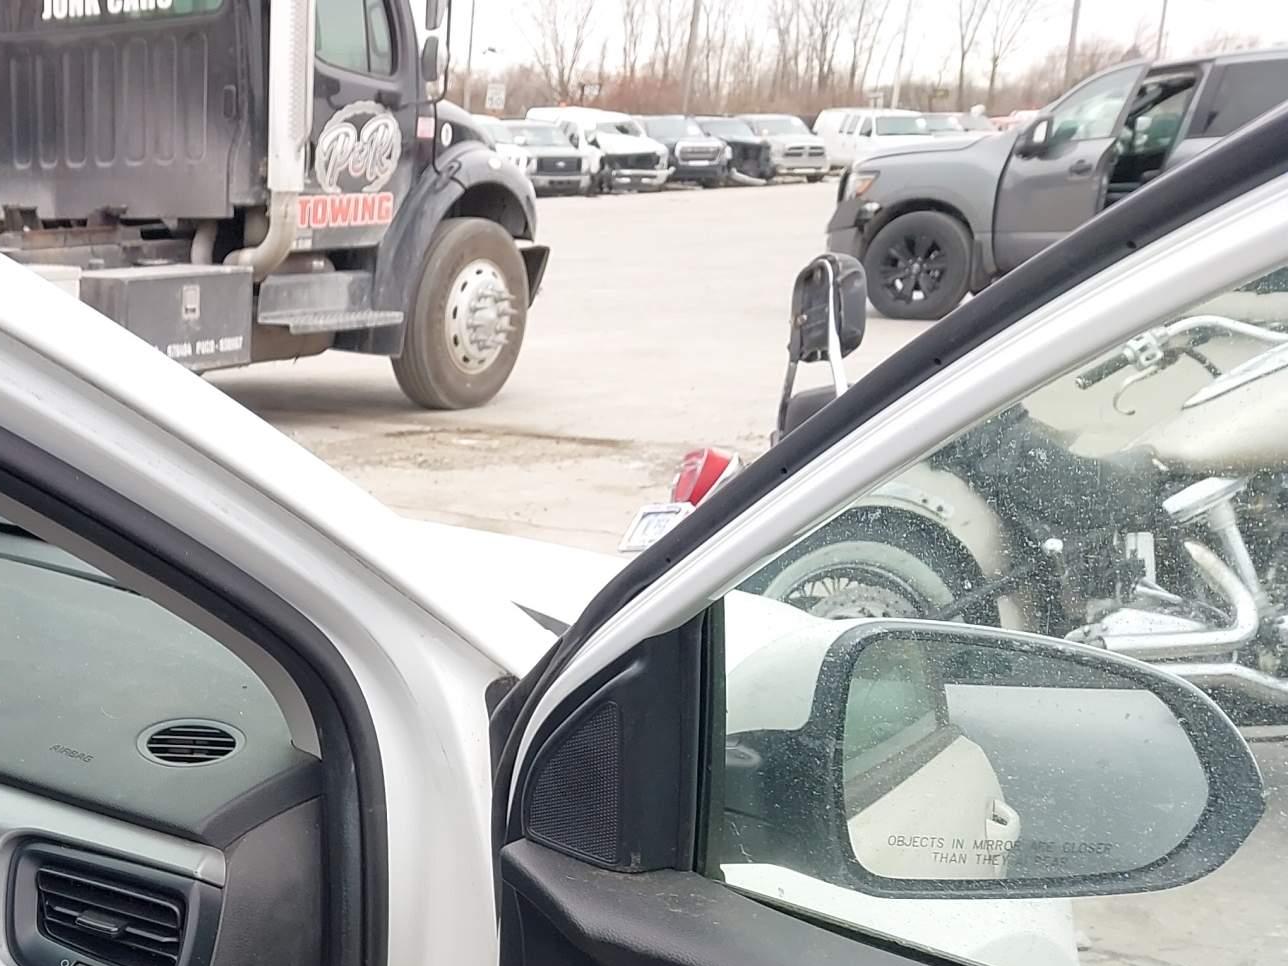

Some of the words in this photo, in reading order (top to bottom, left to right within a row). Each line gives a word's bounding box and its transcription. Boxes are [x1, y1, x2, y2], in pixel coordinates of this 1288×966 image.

[298, 192, 394, 229] TOWING
[48, 744, 95, 763] AIRBAG
[887, 835, 945, 849] OBJECTS
[952, 838, 965, 849] IN
[1062, 841, 1113, 854] CLOSER
[932, 851, 968, 865] THAN
[976, 853, 1010, 866] THEY
